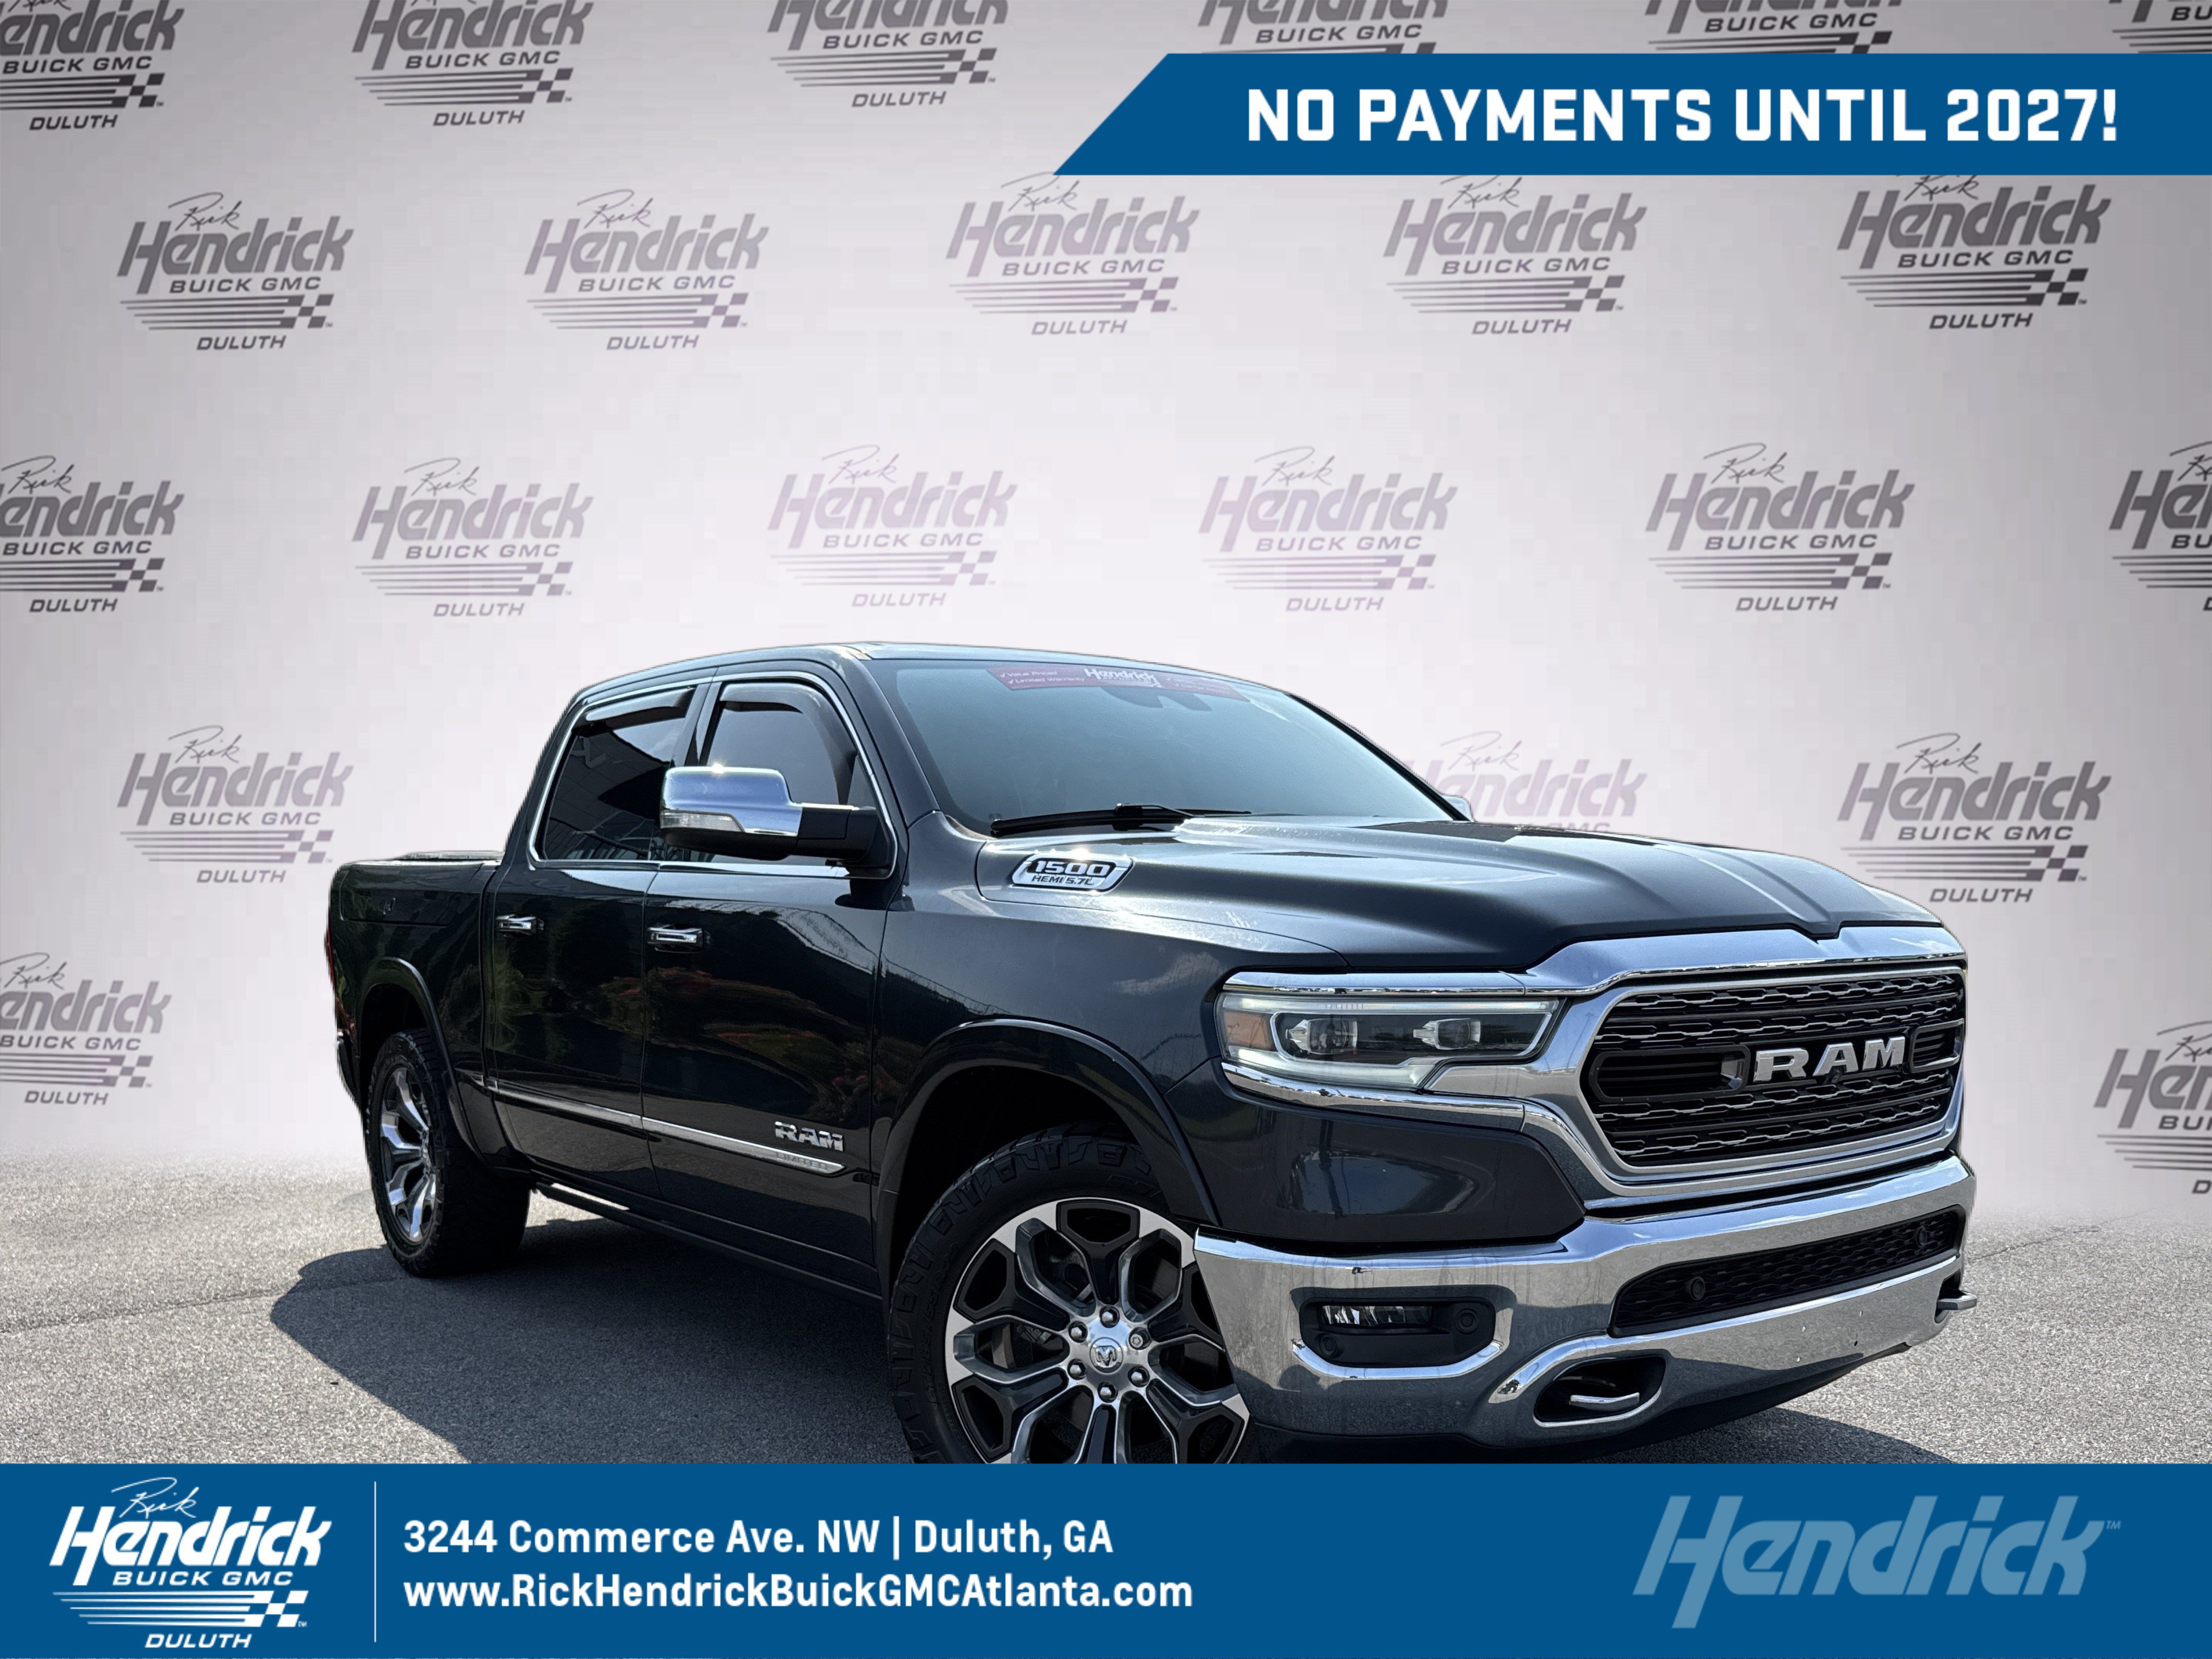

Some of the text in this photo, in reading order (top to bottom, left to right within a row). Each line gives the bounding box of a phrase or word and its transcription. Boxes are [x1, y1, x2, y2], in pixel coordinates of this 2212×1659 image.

[0, 0, 184, 55] endrick
[1705, 15, 1800, 32] BUICK
[1809, 13, 1878, 29] GMC
[352, 0, 594, 70] Hendrick
[823, 31, 983, 49] BUICK GMC
[1256, 25, 1422, 43] BUICK GMC
[3, 57, 153, 74] BUICK GMC
[405, 51, 560, 69] BUICK GMC
[851, 91, 946, 107] DULUTH
[29, 115, 118, 130] DULUTH
[433, 111, 524, 126] DULUTH
[1383, 193, 1647, 275] Hendrick
[1837, 184, 2112, 269] Hendrick
[946, 196, 1200, 278] Hendrick
[116, 216, 354, 294] Hendrick
[524, 213, 769, 293] Hendrick
[1898, 250, 2073, 268] BUICK GMC
[1002, 259, 1165, 275] BUICK GMC
[1441, 257, 1610, 274] BUICK GMC
[170, 277, 321, 293] BUICK GMC
[578, 275, 735, 292] BUICK GMC
[1031, 320, 1127, 335] DULUTH
[1472, 319, 1572, 335] DULUTH
[1929, 313, 2033, 329] DULUTH
[196, 335, 286, 350] DULUTH
[606, 335, 699, 350] DULUTH
[0, 481, 184, 538] endrick
[767, 471, 1018, 549] Hendrick
[1199, 472, 1459, 552] Hendrick
[1645, 470, 1915, 551] Hendrick
[352, 483, 594, 560] Hendrick
[2, 540, 153, 556] BUICK GMC
[823, 533, 983, 549] BUICK GMC
[1256, 536, 1422, 552] BUICK GMC
[1705, 534, 1878, 550] BUICK GMC
[405, 544, 560, 560] BUICK GMC
[29, 598, 118, 612] DULUTH
[851, 592, 946, 607] DULUTH
[1285, 597, 1384, 611] DULUTH
[1735, 596, 1838, 611] DULUTH
[433, 603, 524, 617] DULUTH
[117, 752, 354, 826] Hendrick
[1837, 761, 2112, 841] Hendrick
[170, 812, 321, 826] BUICK GMC
[1898, 826, 2073, 840] BUICK GMC
[1035, 860, 1110, 876] 1500
[196, 870, 286, 883] DULUTH
[1032, 875, 1094, 885] HEMI 5.7L
[1929, 888, 2033, 902] DULUTH
[0, 980, 172, 1034] endrick
[0, 1035, 141, 1051] BUICK GMC
[1753, 1036, 1905, 1082] RAM
[25, 1091, 109, 1105] DULUTH
[775, 1121, 843, 1152] RAM
